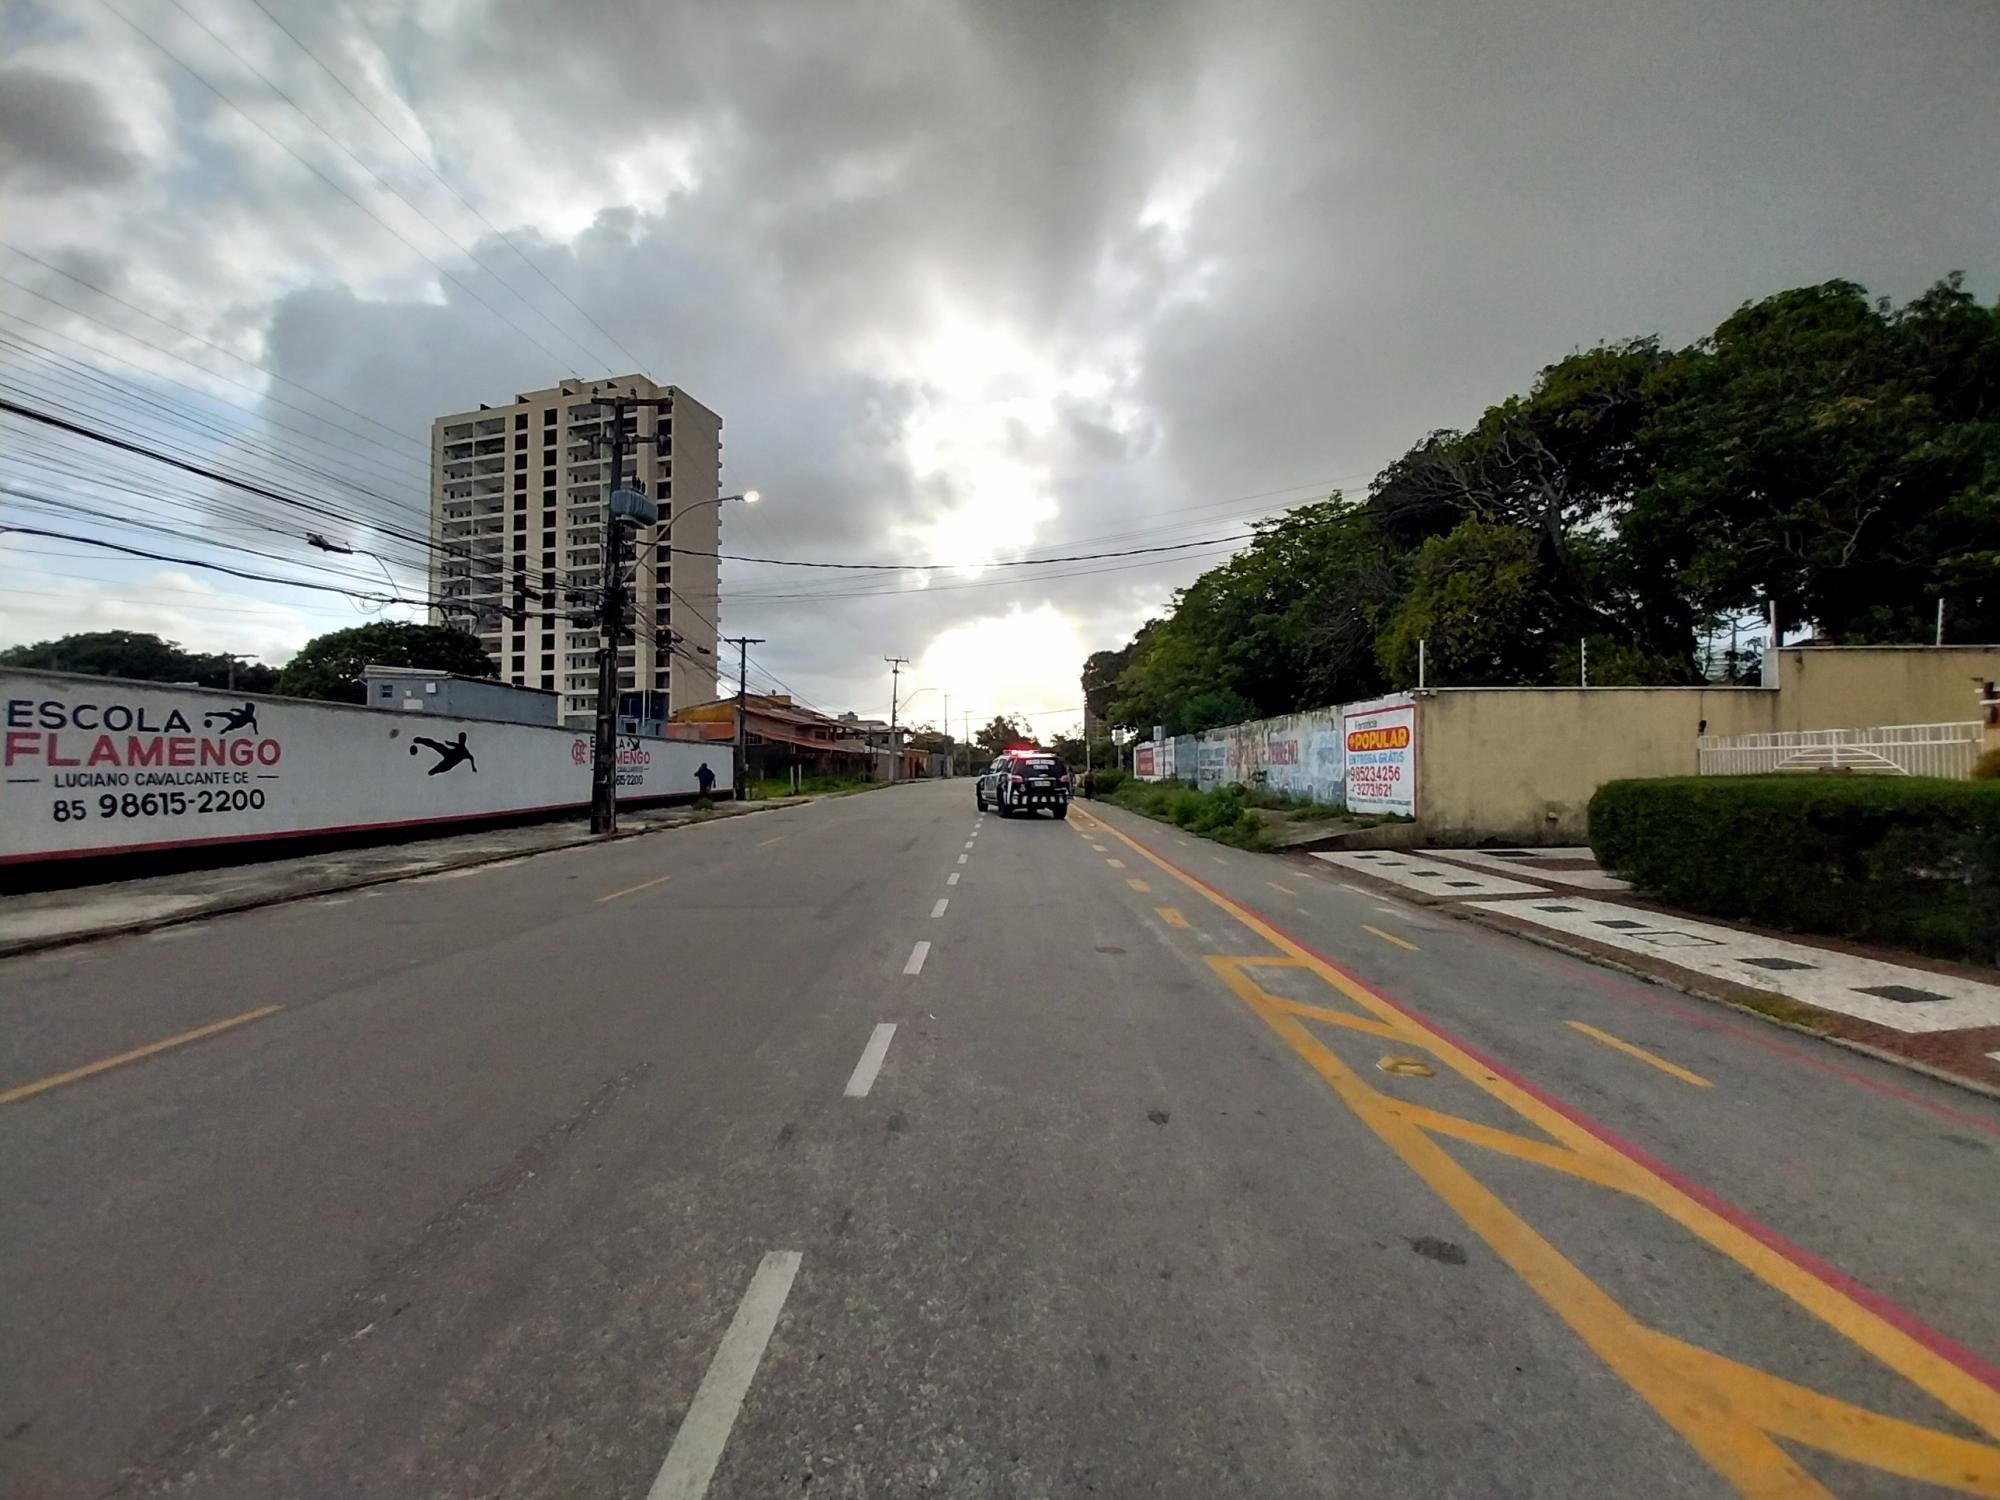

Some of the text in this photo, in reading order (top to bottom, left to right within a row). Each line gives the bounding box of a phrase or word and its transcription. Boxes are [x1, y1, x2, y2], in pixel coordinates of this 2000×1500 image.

[8, 700, 191, 733] ESCOLA
[5, 732, 281, 767] FLAMENGO
[1355, 729, 1407, 750] POPULAR
[54, 772, 249, 788] LUCIANO CAVALCANTE CE
[53, 789, 265, 822] 85 98615-2200
